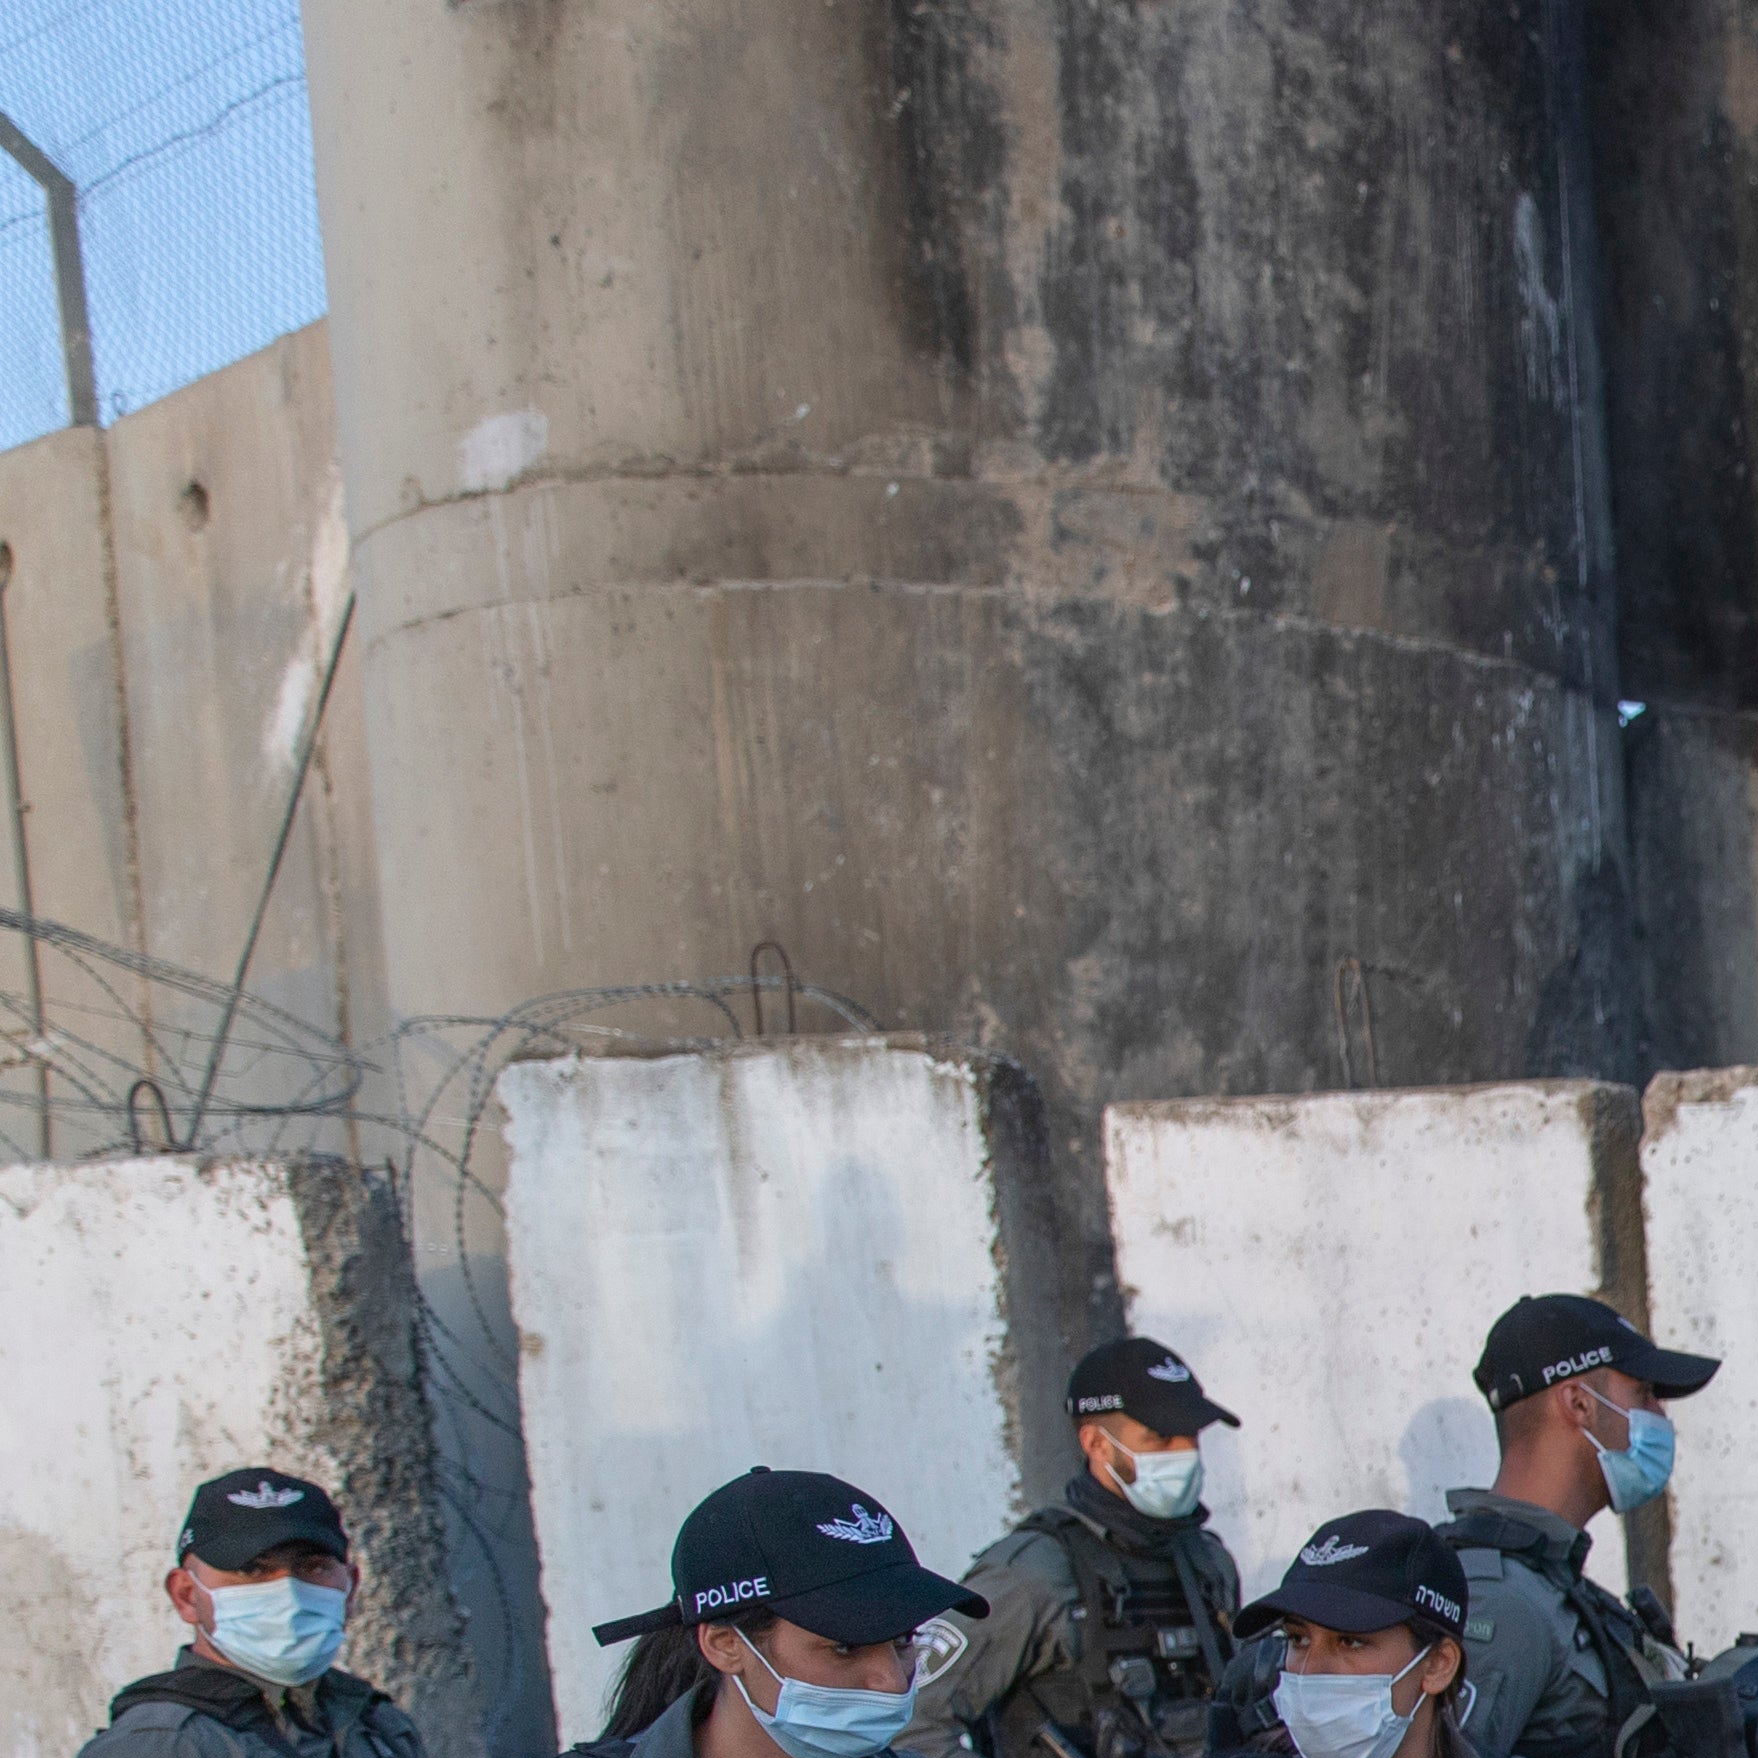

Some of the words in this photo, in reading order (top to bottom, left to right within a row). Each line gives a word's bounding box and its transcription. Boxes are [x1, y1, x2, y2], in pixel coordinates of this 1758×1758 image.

[1541, 1346, 1614, 1385] POLICE
[1079, 1395, 1124, 1413] POLICE
[695, 1576, 771, 1614] POLICE
[1415, 1584, 1461, 1623] משטרה
